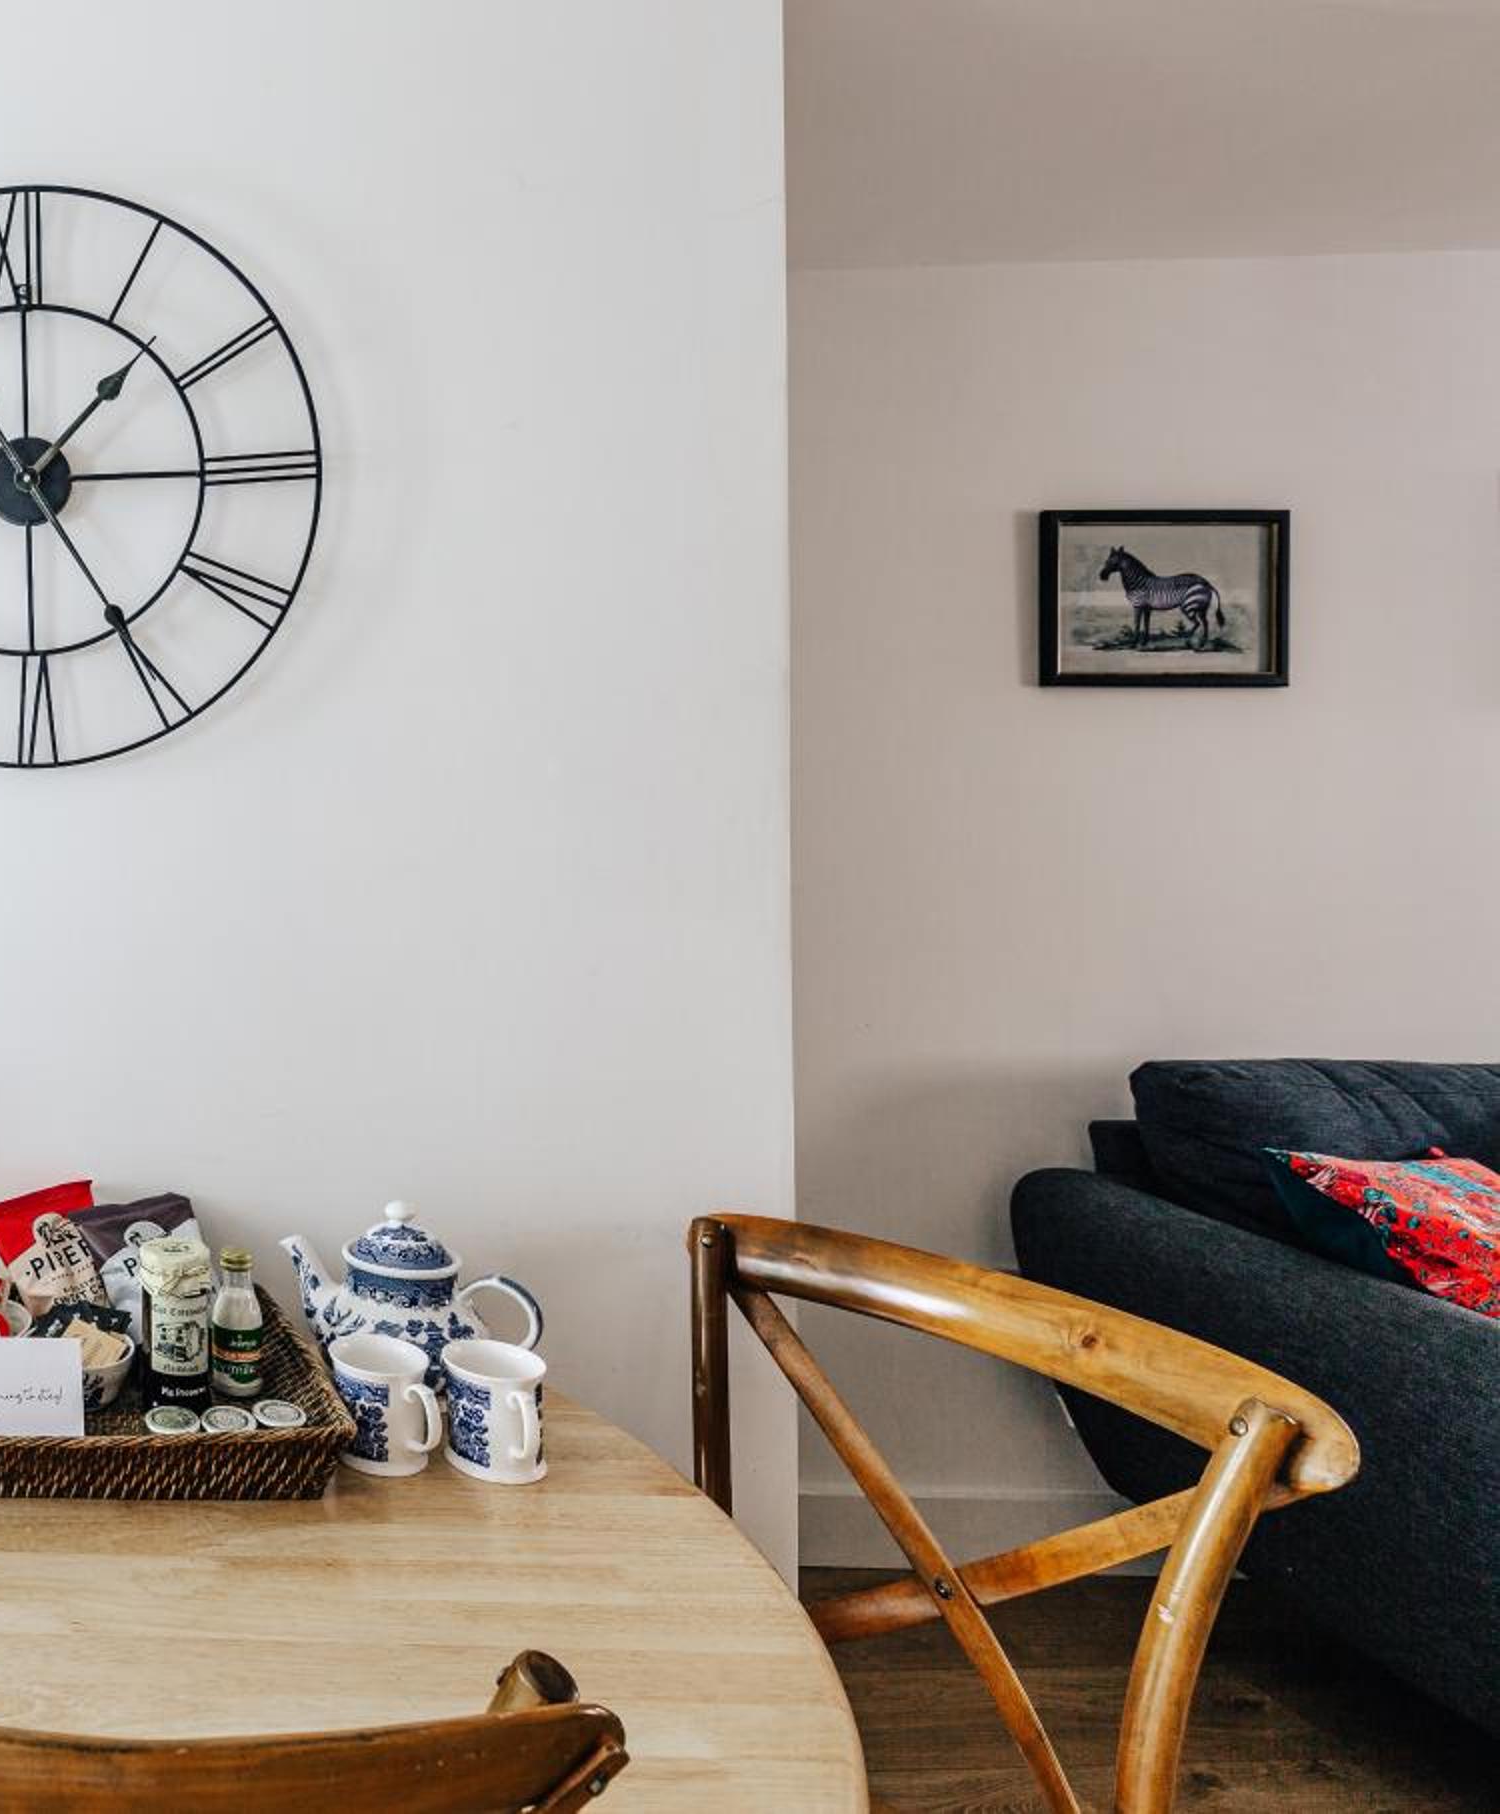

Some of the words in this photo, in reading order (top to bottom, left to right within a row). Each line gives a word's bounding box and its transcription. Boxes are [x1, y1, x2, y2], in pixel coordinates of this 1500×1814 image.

[107, 219, 163, 322] I
[175, 315, 280, 391] II
[203, 450, 318, 486] III
[17, 654, 59, 767] VI
